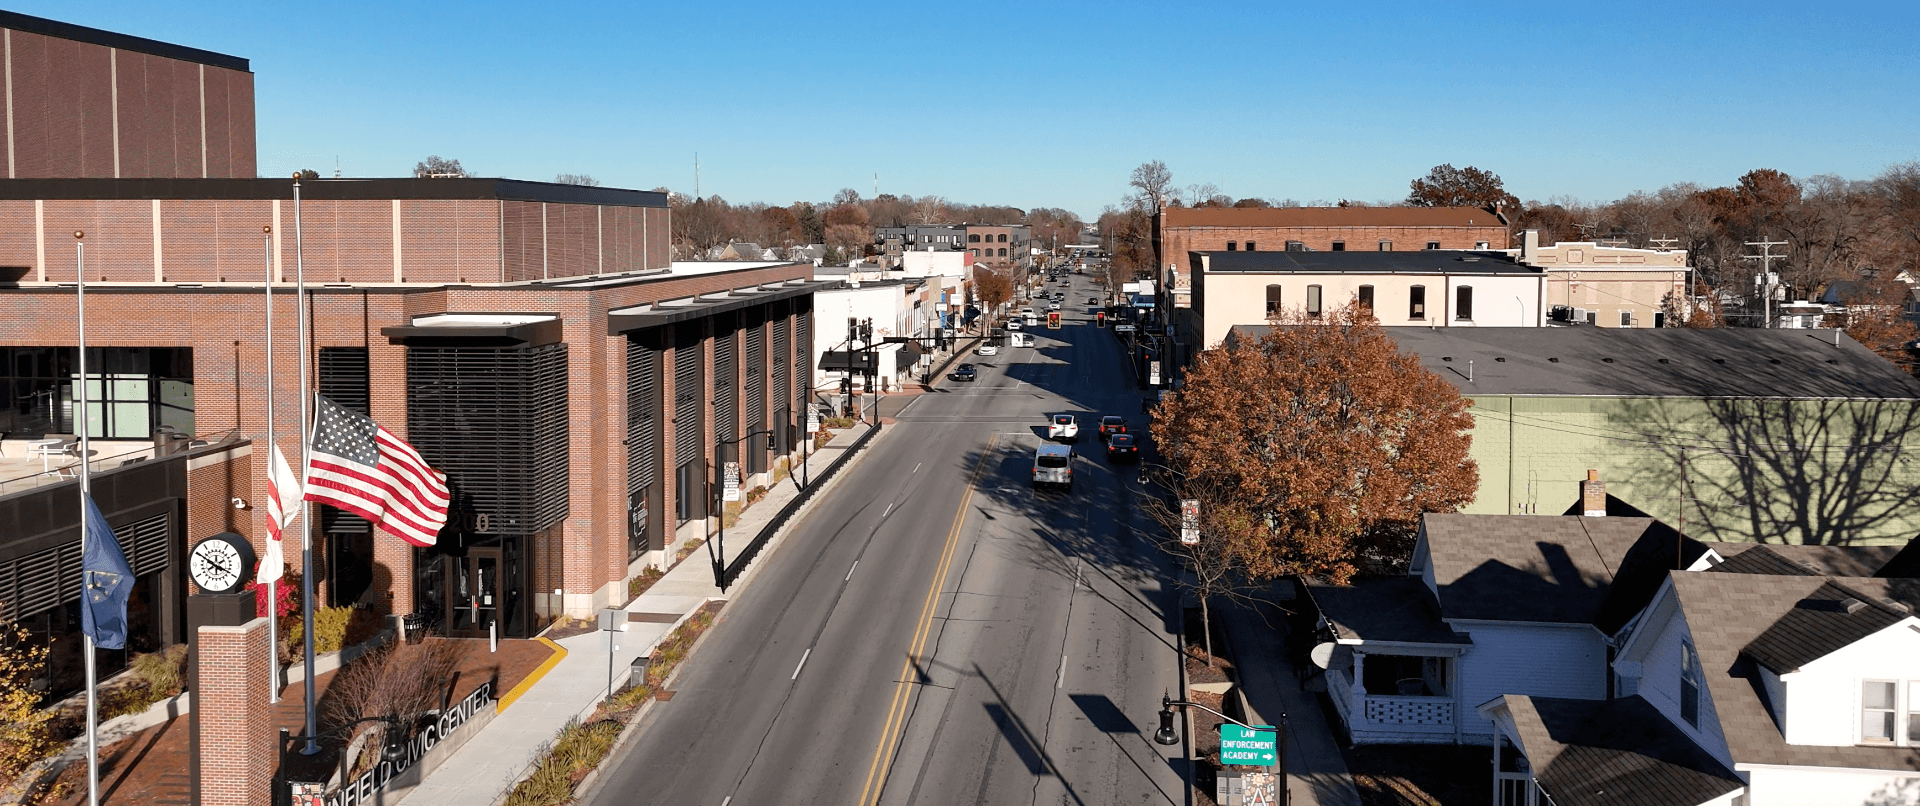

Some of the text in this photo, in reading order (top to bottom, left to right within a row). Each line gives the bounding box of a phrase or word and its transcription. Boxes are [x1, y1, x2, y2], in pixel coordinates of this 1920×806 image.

[212, 540, 220, 549] 12
[437, 683, 492, 740] CENTER
[1240, 730, 1256, 738] LAW
[1222, 740, 1273, 749] ENFORCEMENT
[1223, 751, 1258, 760] ACADEMY
